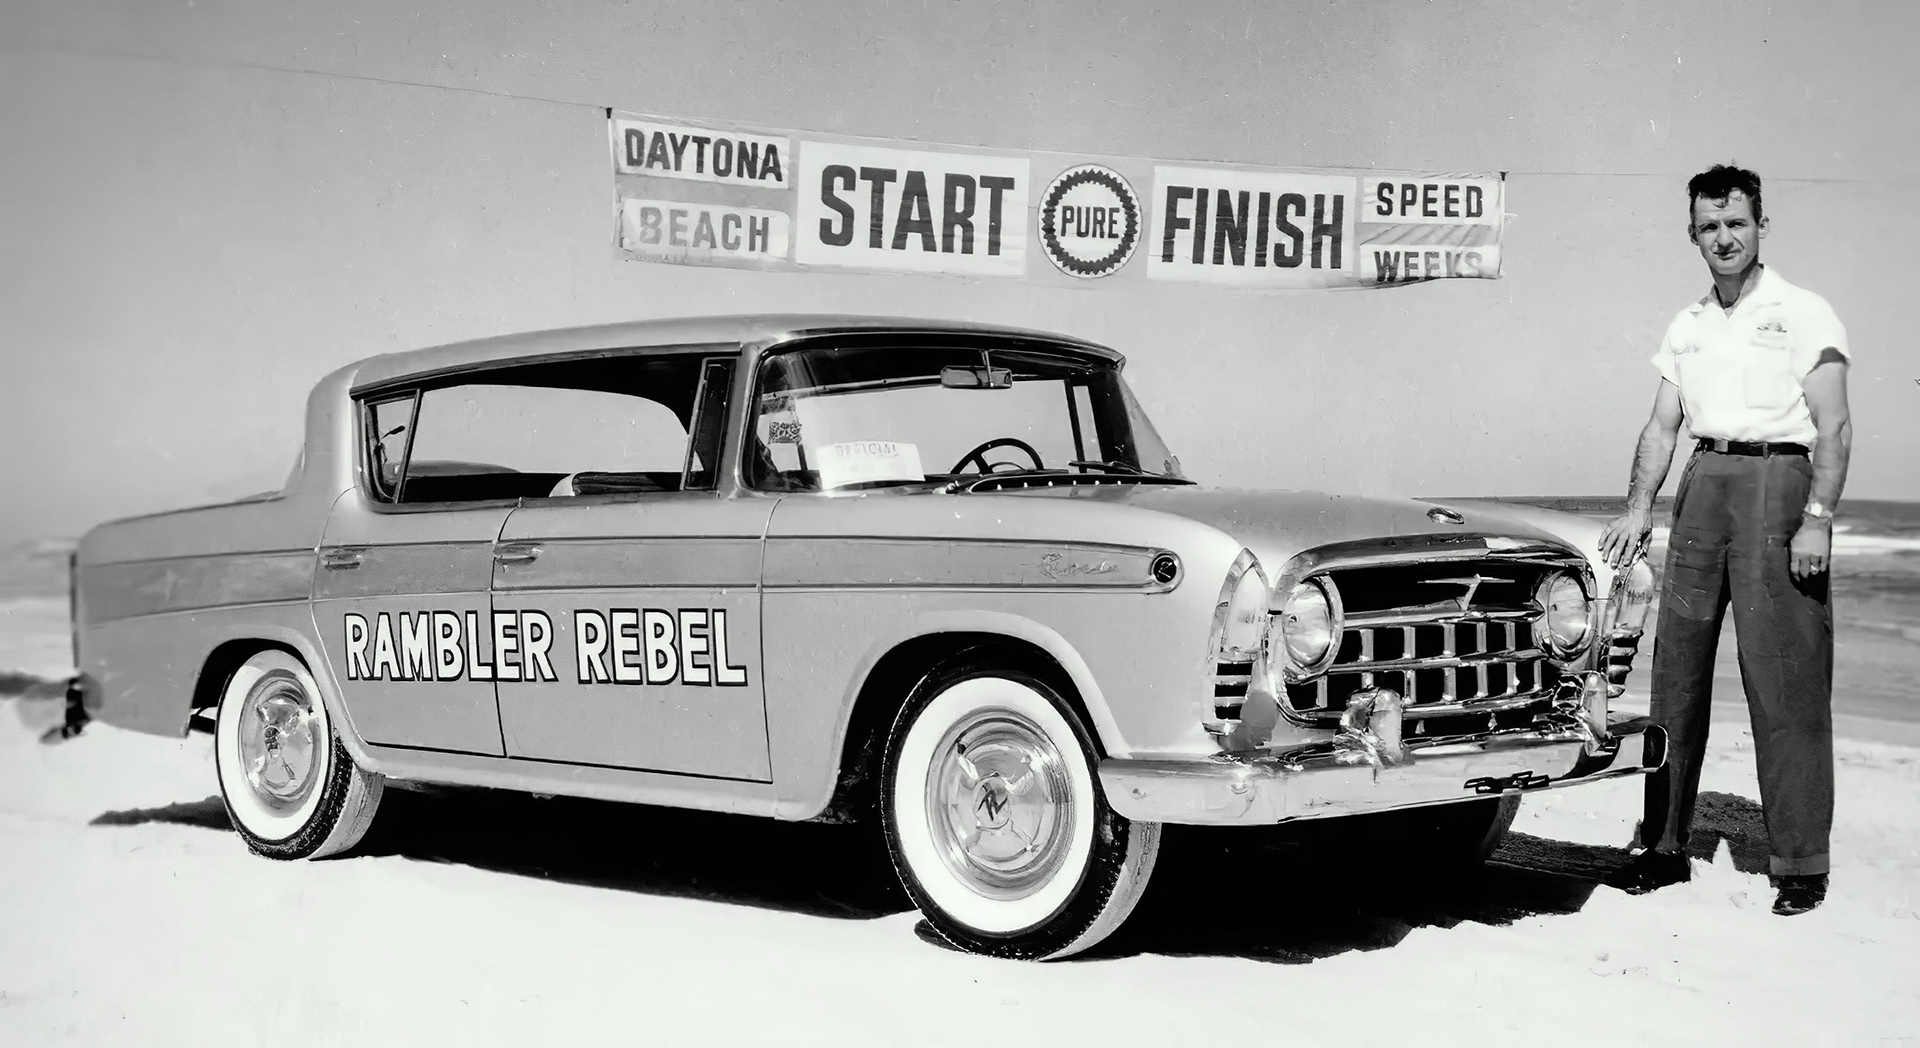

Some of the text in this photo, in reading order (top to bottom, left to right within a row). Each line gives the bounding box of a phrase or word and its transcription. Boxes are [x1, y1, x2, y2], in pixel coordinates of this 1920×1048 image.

[624, 127, 784, 183] DAYTONA
[818, 164, 1016, 257] START
[1060, 205, 1121, 240] PURE
[1161, 185, 1345, 270] FINISH
[1376, 181, 1484, 218] SPEED
[639, 206, 770, 253] BEACH
[344, 608, 748, 687] RAMBLER REBEL
